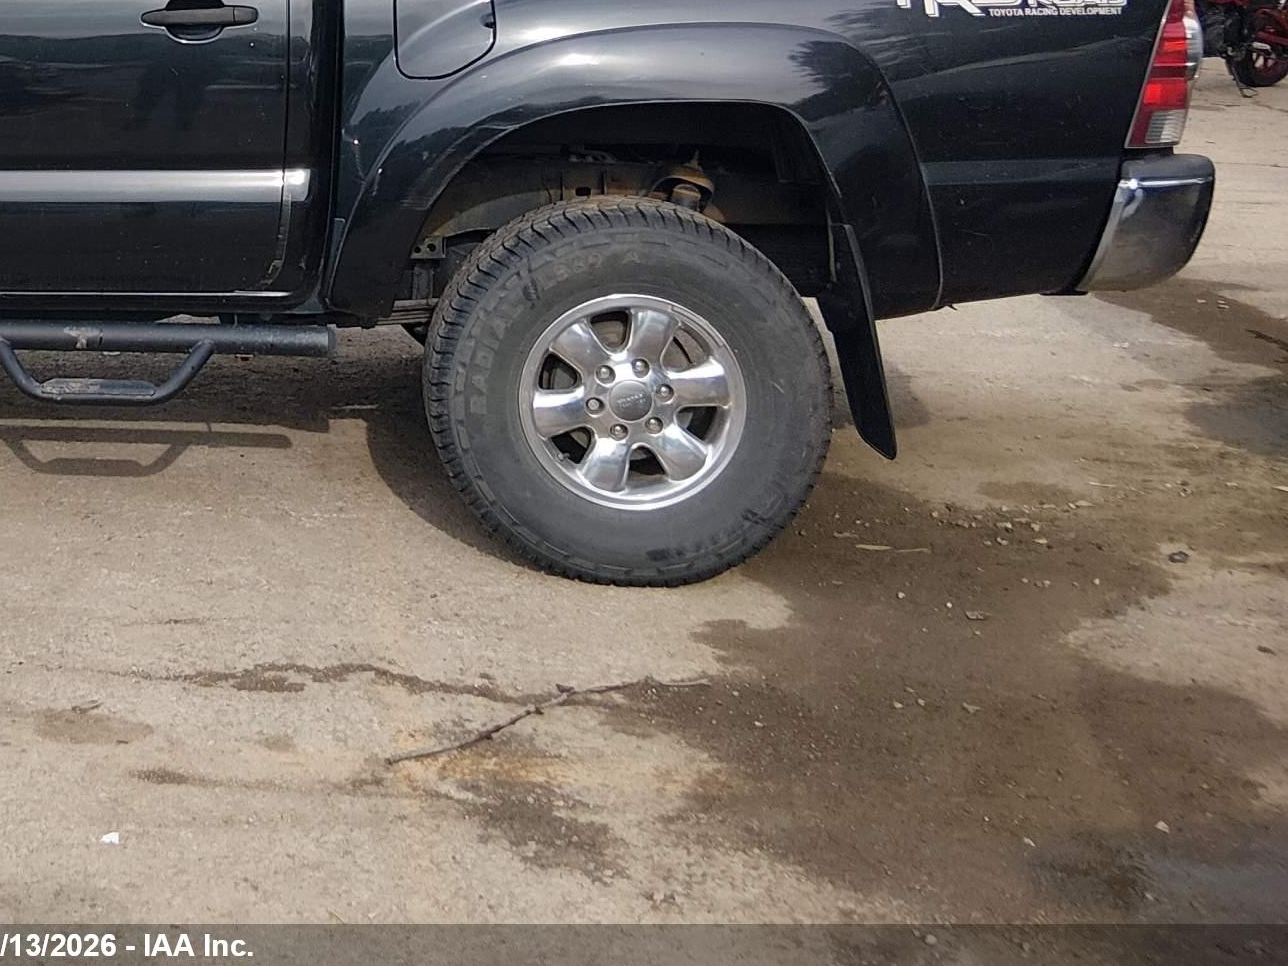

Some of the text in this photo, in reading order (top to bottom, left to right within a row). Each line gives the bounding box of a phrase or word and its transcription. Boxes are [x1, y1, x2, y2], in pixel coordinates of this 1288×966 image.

[988, 6, 1123, 17] TOYOTA RACING DEVELOPMENT
